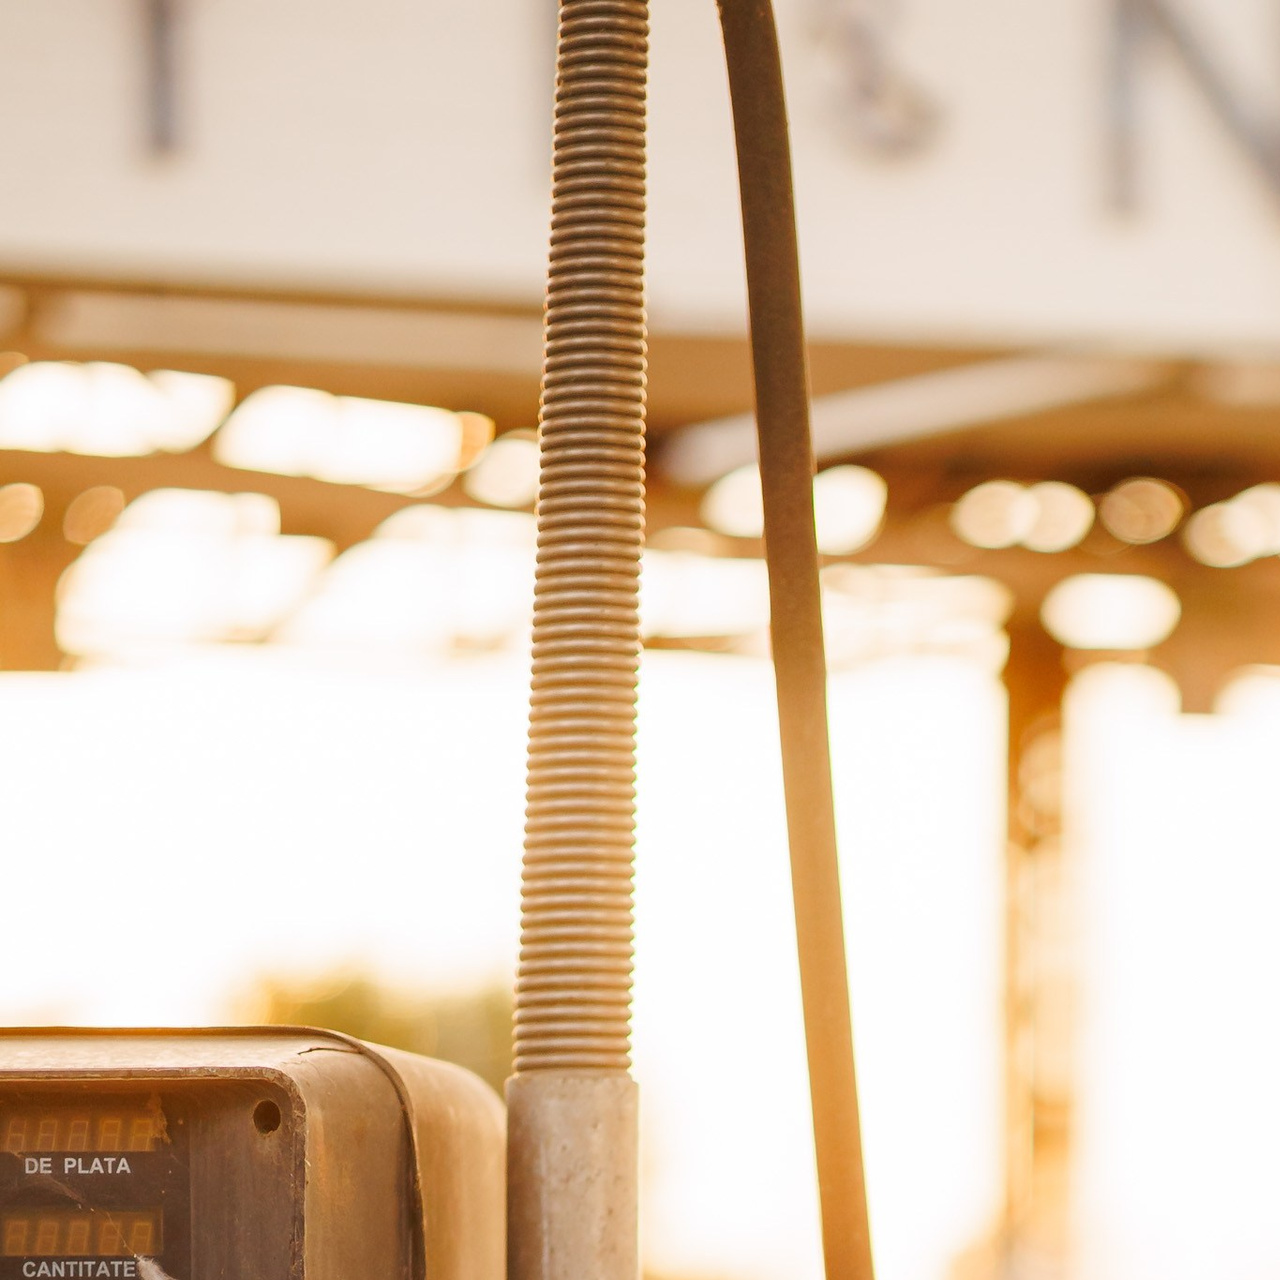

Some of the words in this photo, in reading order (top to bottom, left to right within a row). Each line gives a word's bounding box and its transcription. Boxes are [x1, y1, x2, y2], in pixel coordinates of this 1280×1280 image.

[24, 1157, 53, 1174] DE
[63, 1157, 132, 1174] PLATA
[22, 1260, 137, 1278] CANTITATE
